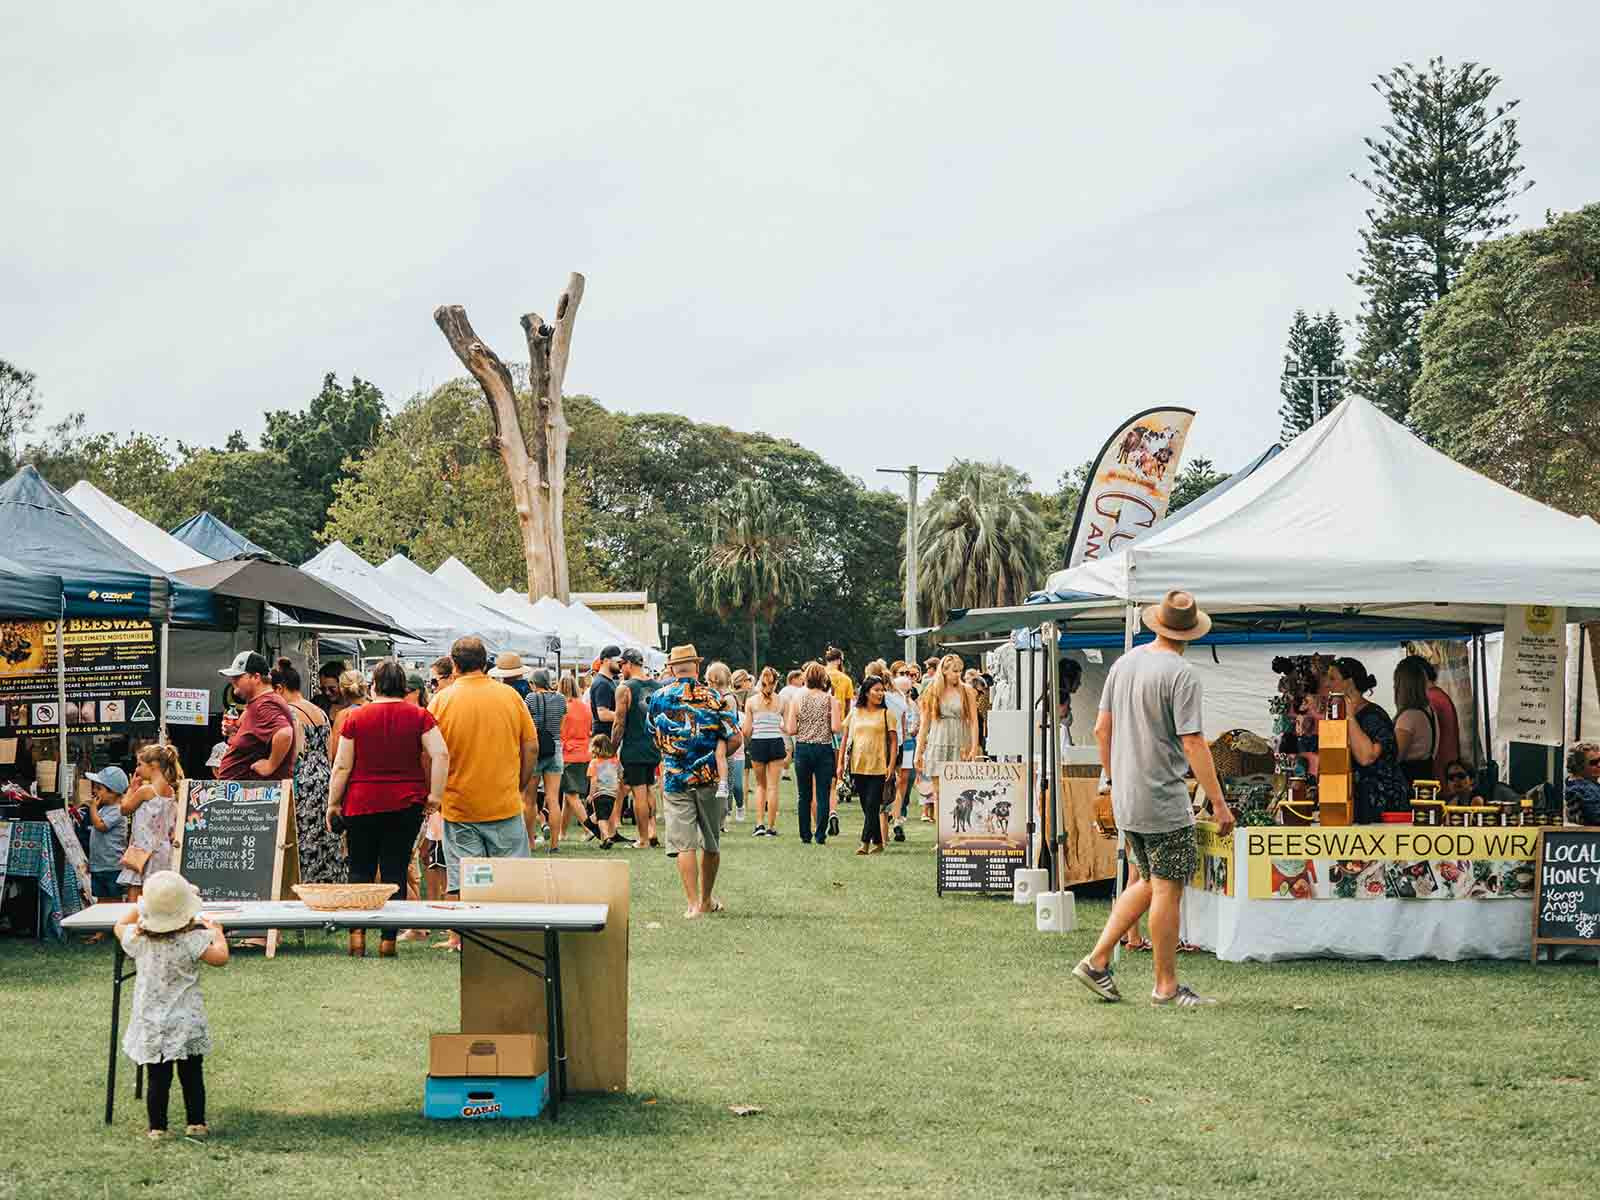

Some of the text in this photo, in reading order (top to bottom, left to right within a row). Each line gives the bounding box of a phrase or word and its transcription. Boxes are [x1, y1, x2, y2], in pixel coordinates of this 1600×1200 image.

[70, 620, 152, 631] BEESWAX
[166, 700, 201, 712] FREE
[944, 765, 1024, 780] GUARDIAN
[188, 834, 256, 848] FACE PAINT $8
[1248, 834, 1386, 856] BEESWAX
[1395, 834, 1474, 856] FOOD
[210, 849, 240, 861] DESIGN
[240, 848, 256, 860] $5
[1545, 842, 1600, 863] LOCAL
[216, 860, 240, 870] CHEEK
[241, 860, 256, 871] $2
[1543, 866, 1600, 886] HONEY
